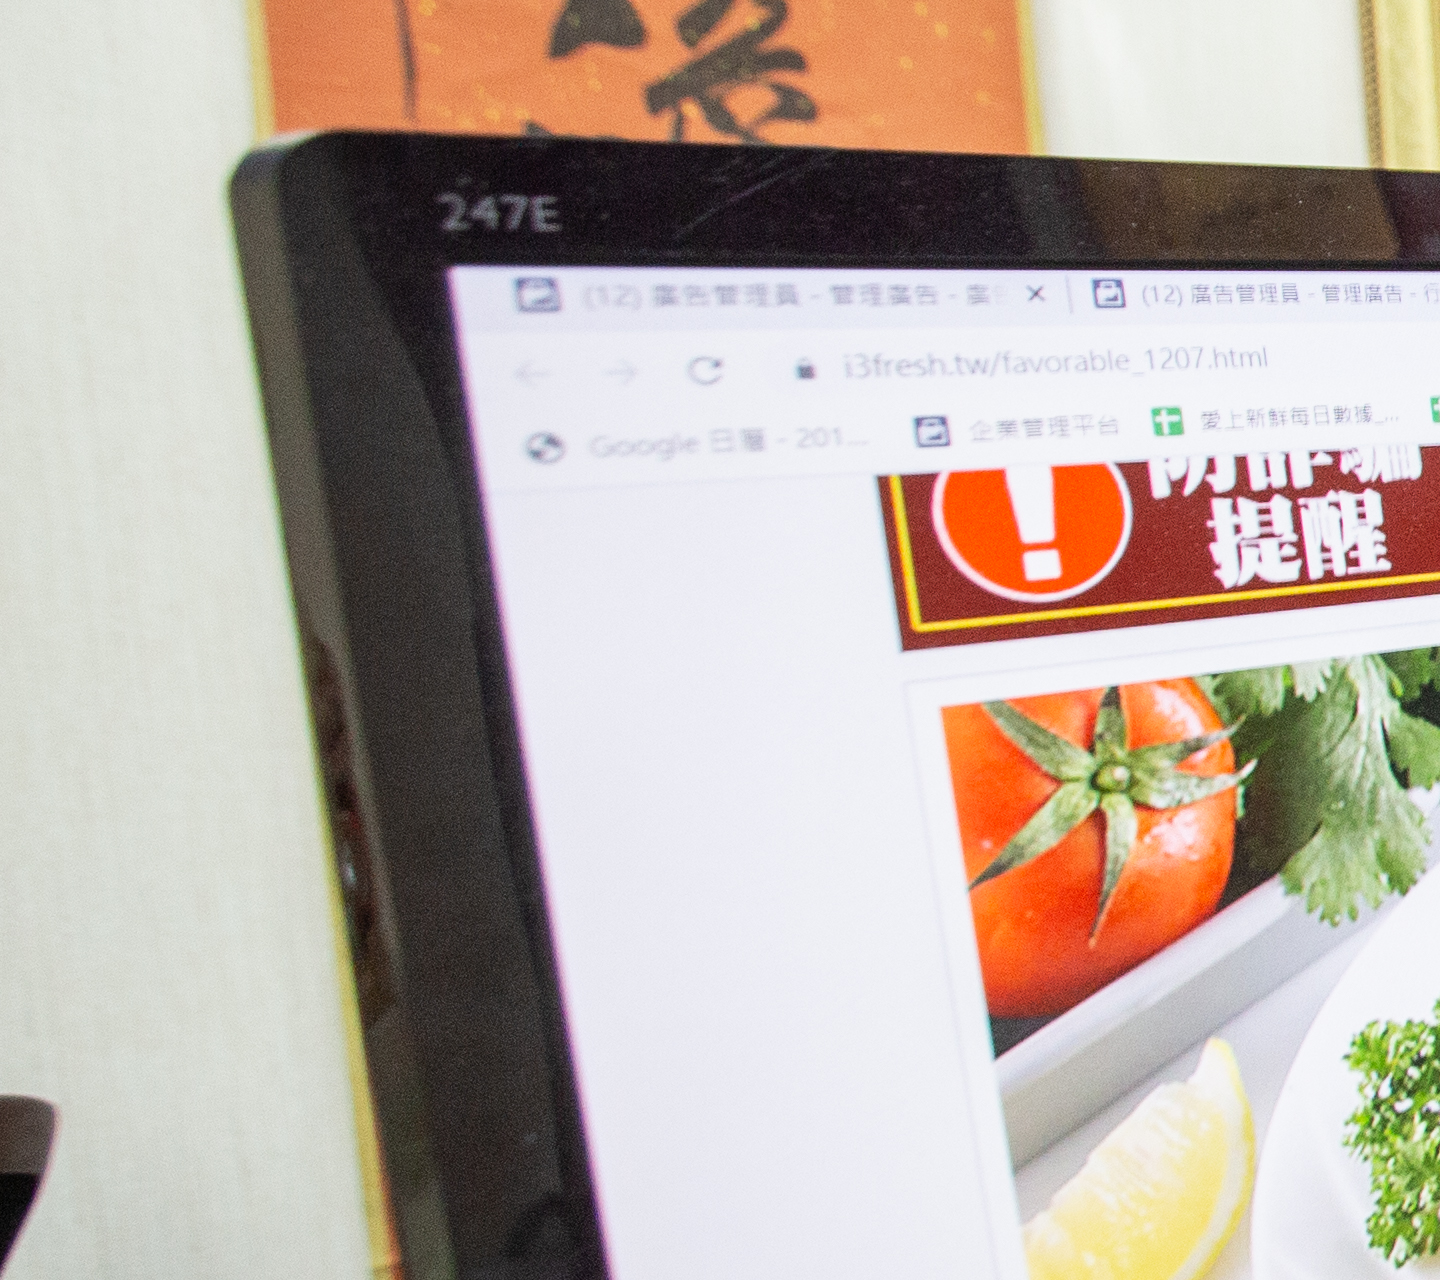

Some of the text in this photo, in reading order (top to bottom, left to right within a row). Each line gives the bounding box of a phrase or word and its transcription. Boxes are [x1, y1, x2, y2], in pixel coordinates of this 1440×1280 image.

[436, 192, 563, 233] 247E
[842, 346, 1269, 379] i3fresh.tw/favorable_1207.html
[969, 414, 1120, 442] 企業管理平台
[1207, 488, 1392, 588] 提醒
